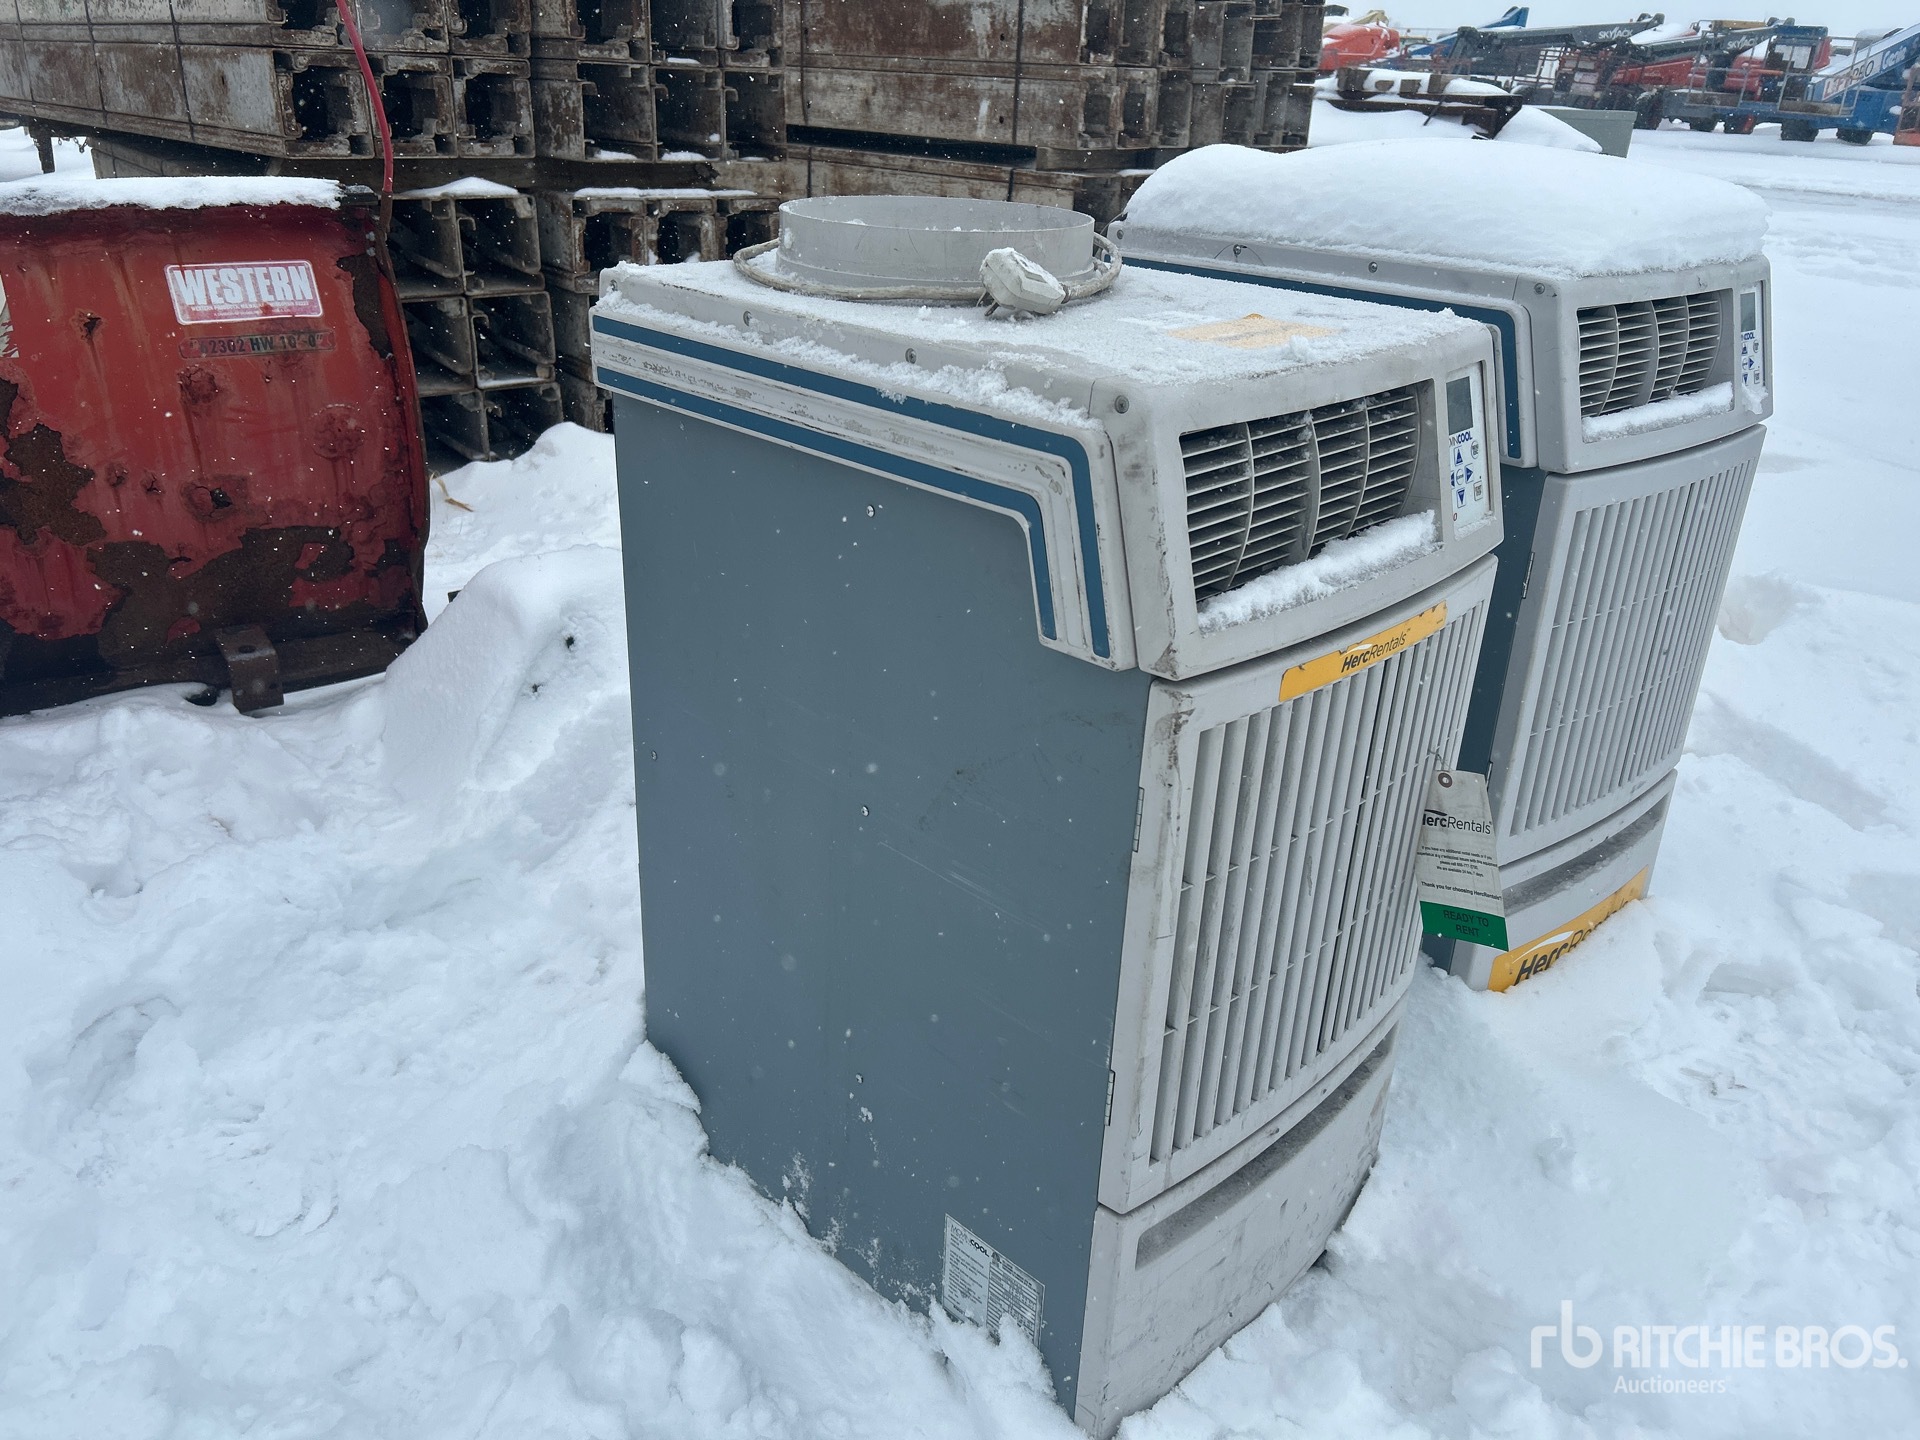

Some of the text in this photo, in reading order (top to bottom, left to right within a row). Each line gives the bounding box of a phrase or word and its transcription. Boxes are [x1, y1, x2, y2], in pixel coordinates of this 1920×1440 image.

[1598, 27, 1633, 40] SKYJACK
[173, 265, 313, 305] WESTERN
[250, 336, 274, 351] HW
[1341, 631, 1406, 673] HercRentals
[1443, 910, 1488, 927] READY TO
[1456, 924, 1479, 936] RENT
